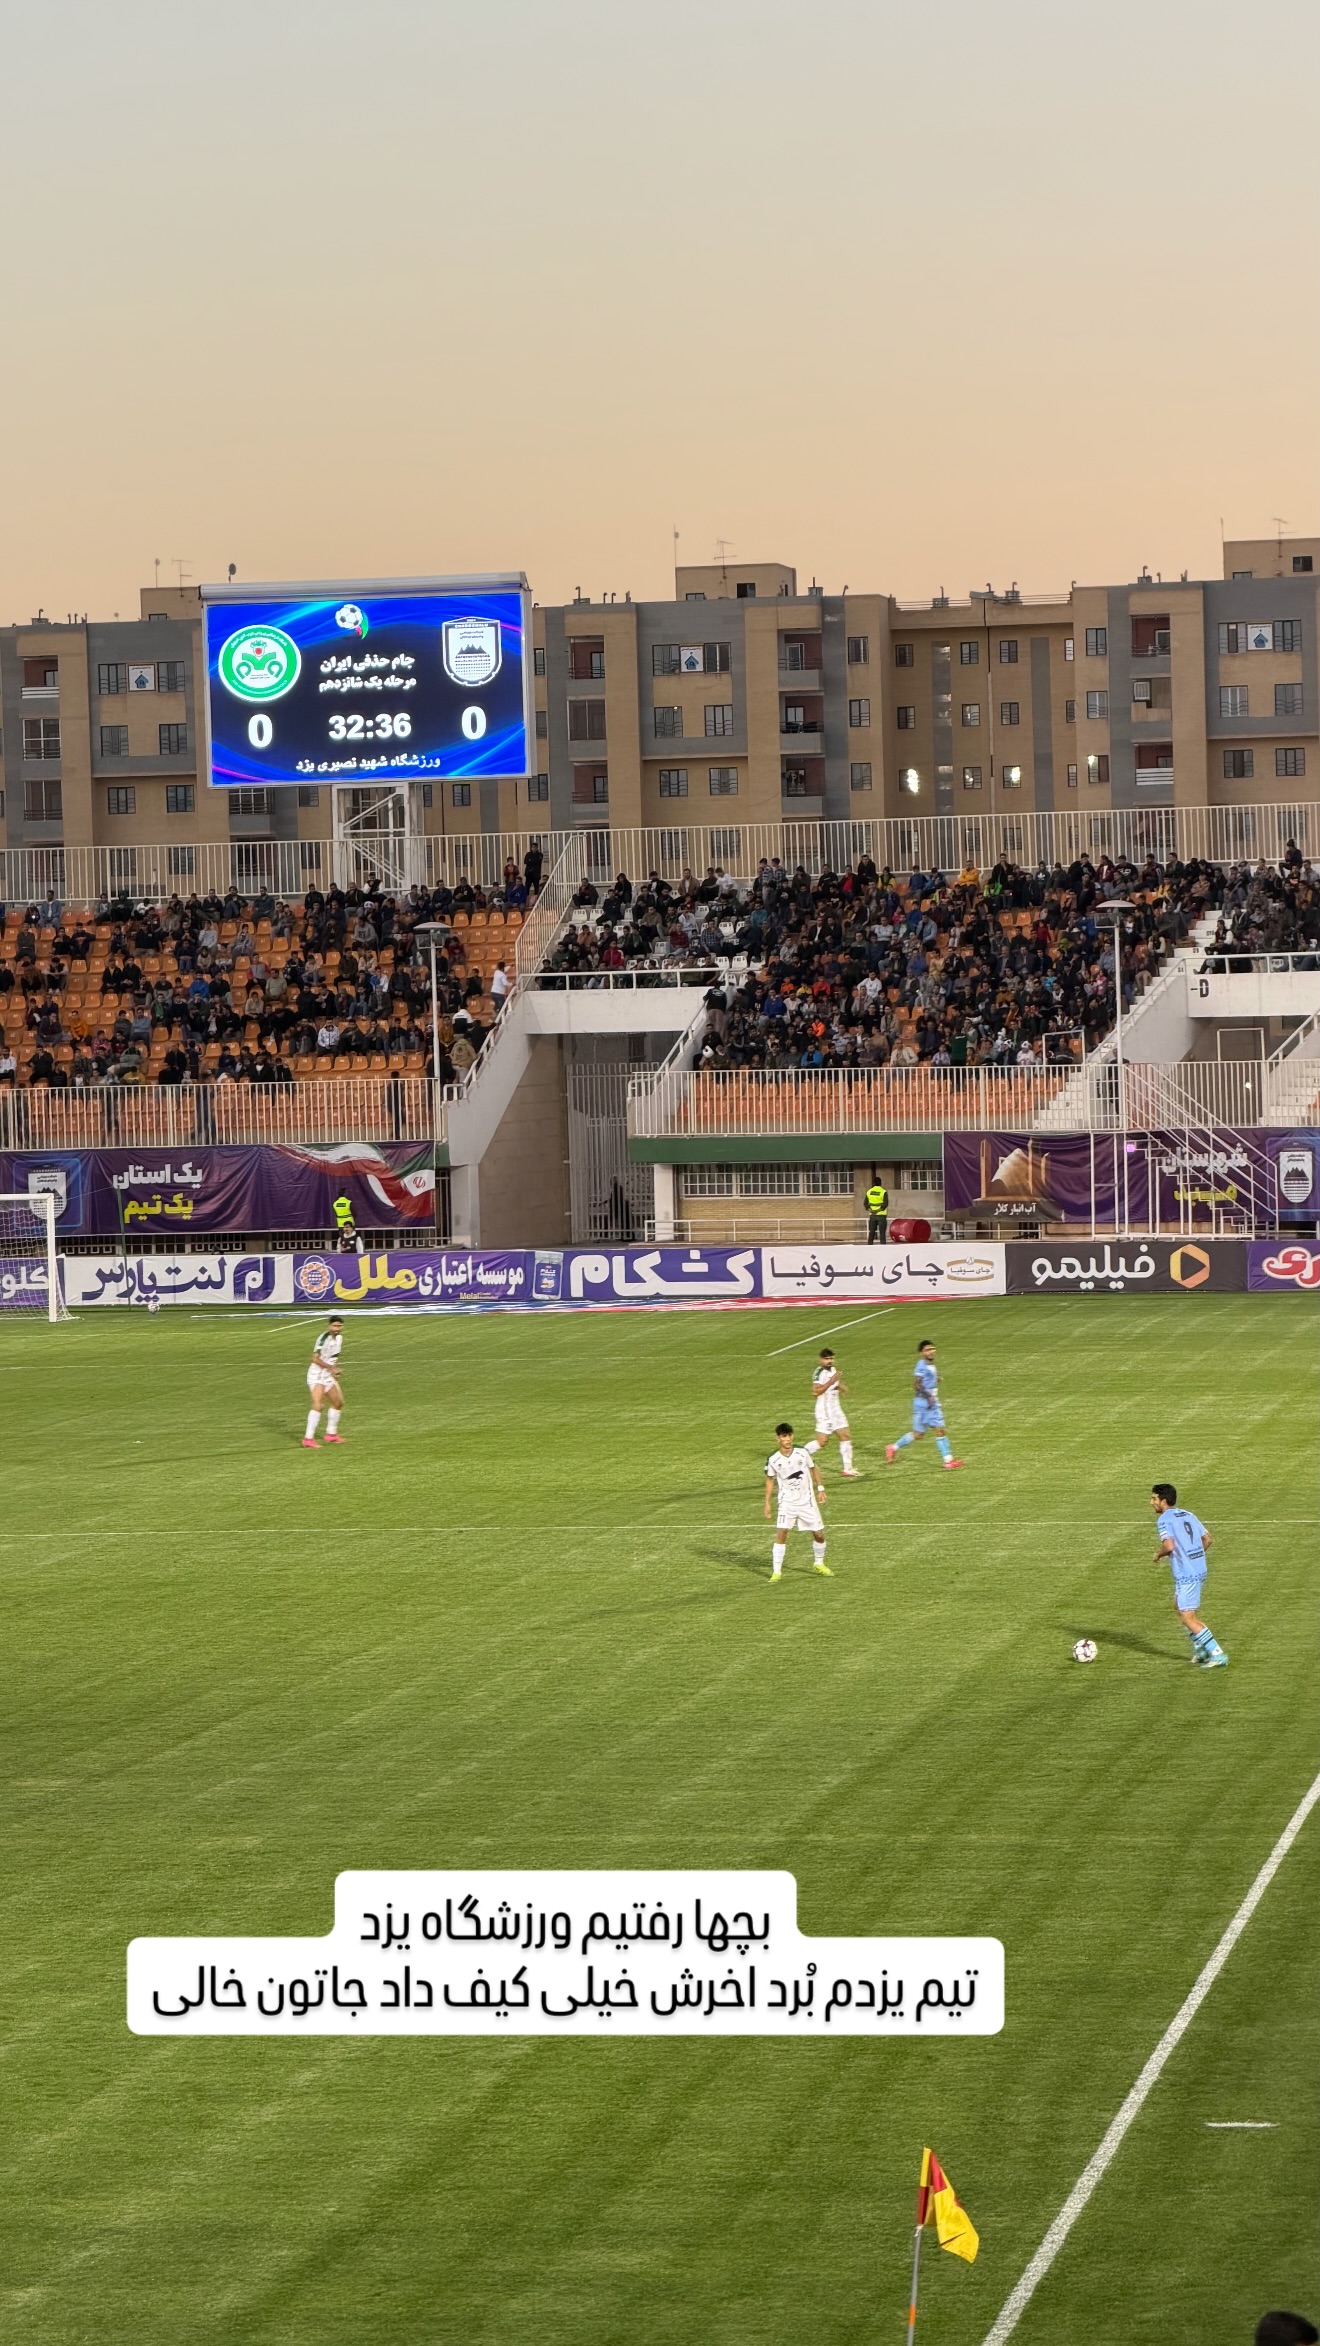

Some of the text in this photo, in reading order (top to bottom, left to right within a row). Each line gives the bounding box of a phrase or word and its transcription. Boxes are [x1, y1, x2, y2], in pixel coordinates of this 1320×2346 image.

[320, 653, 416, 674] جام حذفی ایران
[319, 674, 417, 693] مرحله یک شانزدهم
[248, 714, 273, 748] 0
[328, 712, 412, 740] 32:36
[462, 706, 487, 740] 0
[296, 753, 441, 773] ورزشگاه شهید نصیری یزد
[112, 1161, 203, 1190] یک استان
[124, 1192, 193, 1224] یک تیم
[1008, 1203, 1025, 1216] انبار
[1024, 1202, 1037, 1216] آب
[333, 1253, 524, 1301] موسسه اعتباری ملل
[770, 1254, 944, 1288] چای سوفیا
[1031, 1244, 1156, 1290] فیلیمو
[1183, 1521, 1194, 1545] 9
